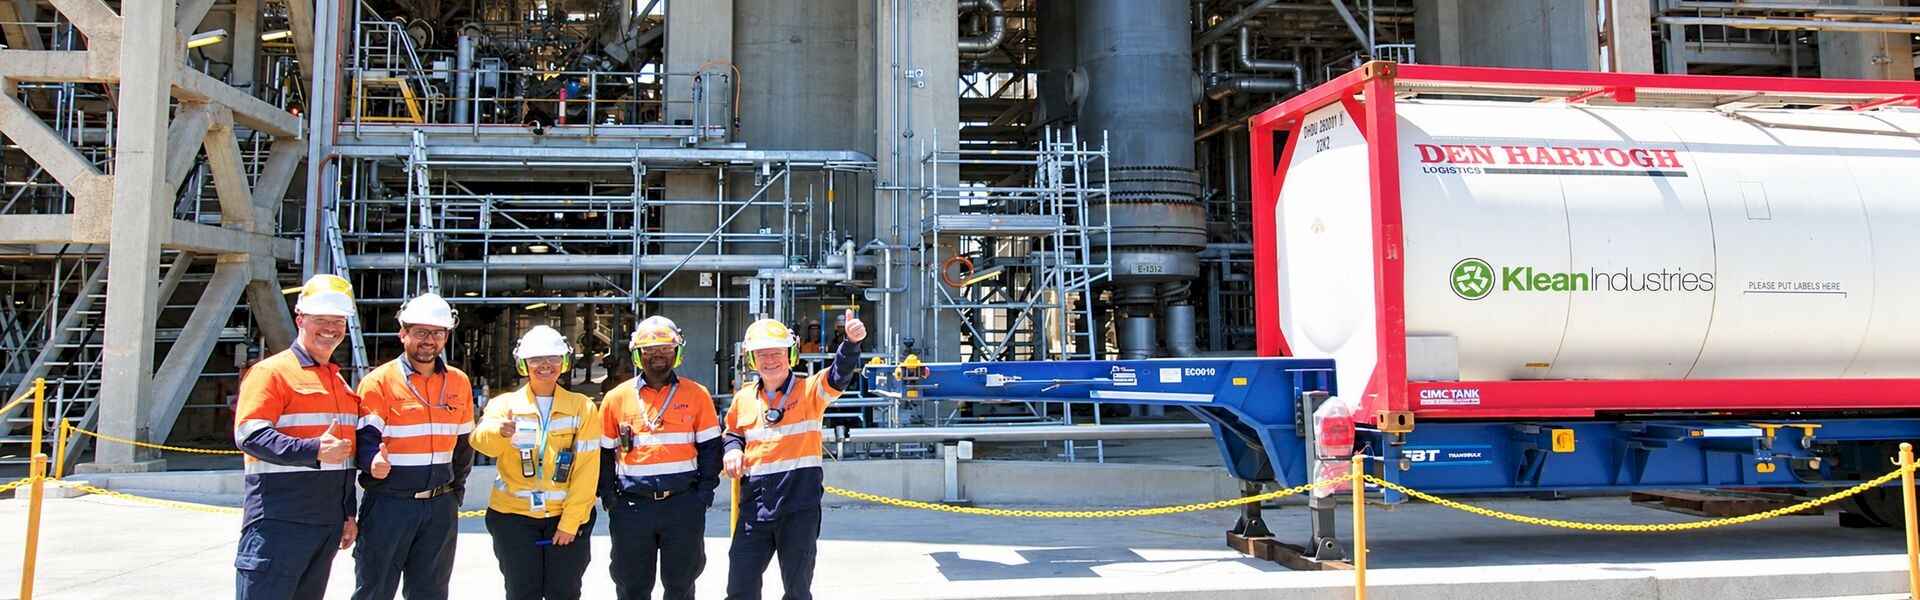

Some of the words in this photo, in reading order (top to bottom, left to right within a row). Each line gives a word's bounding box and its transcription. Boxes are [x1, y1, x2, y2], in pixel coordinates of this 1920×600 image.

[1414, 143, 1495, 165] DEN
[1500, 145, 1684, 168] HARTOGH
[1423, 166, 1482, 175] LOGISTICS
[1748, 281, 1776, 290] PLEASE
[1778, 281, 1792, 290] PUT
[1793, 282, 1820, 290] LABELS
[1821, 282, 1840, 290] HERE
[1420, 389, 1450, 399] CIMC
[1450, 389, 1480, 398] TANK
